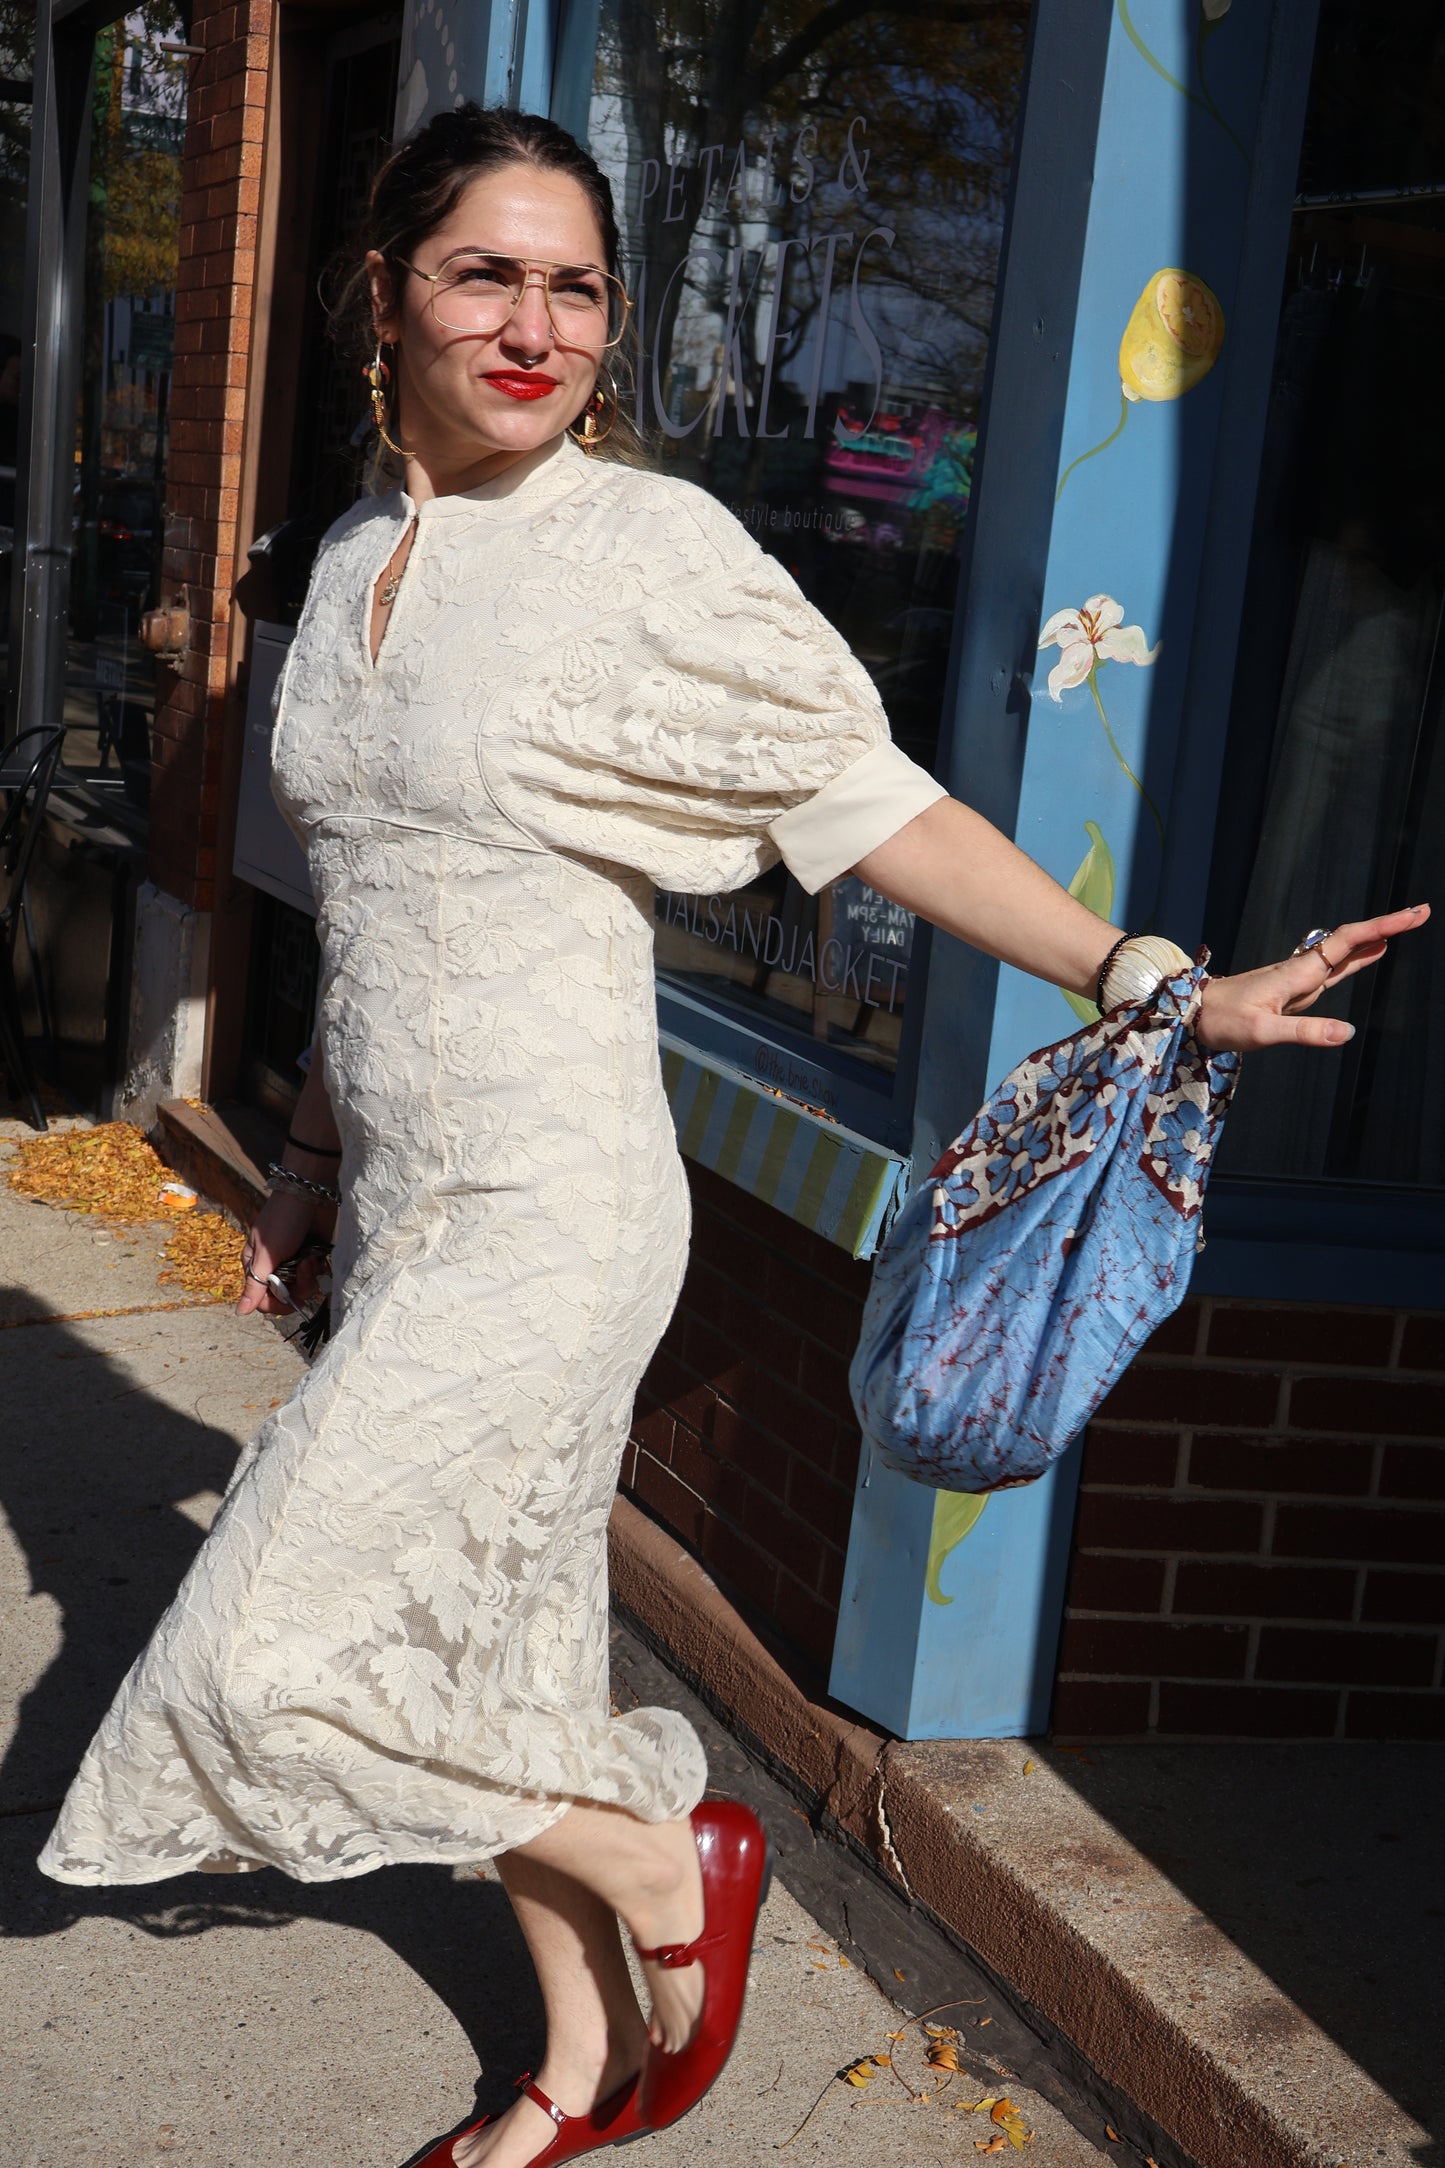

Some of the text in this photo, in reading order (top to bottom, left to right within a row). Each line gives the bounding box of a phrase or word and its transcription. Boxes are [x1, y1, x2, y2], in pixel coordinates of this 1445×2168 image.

[636, 115, 871, 227] PETALS &
[616, 227, 896, 440] ACKETS
[784, 505, 855, 536] boutique
